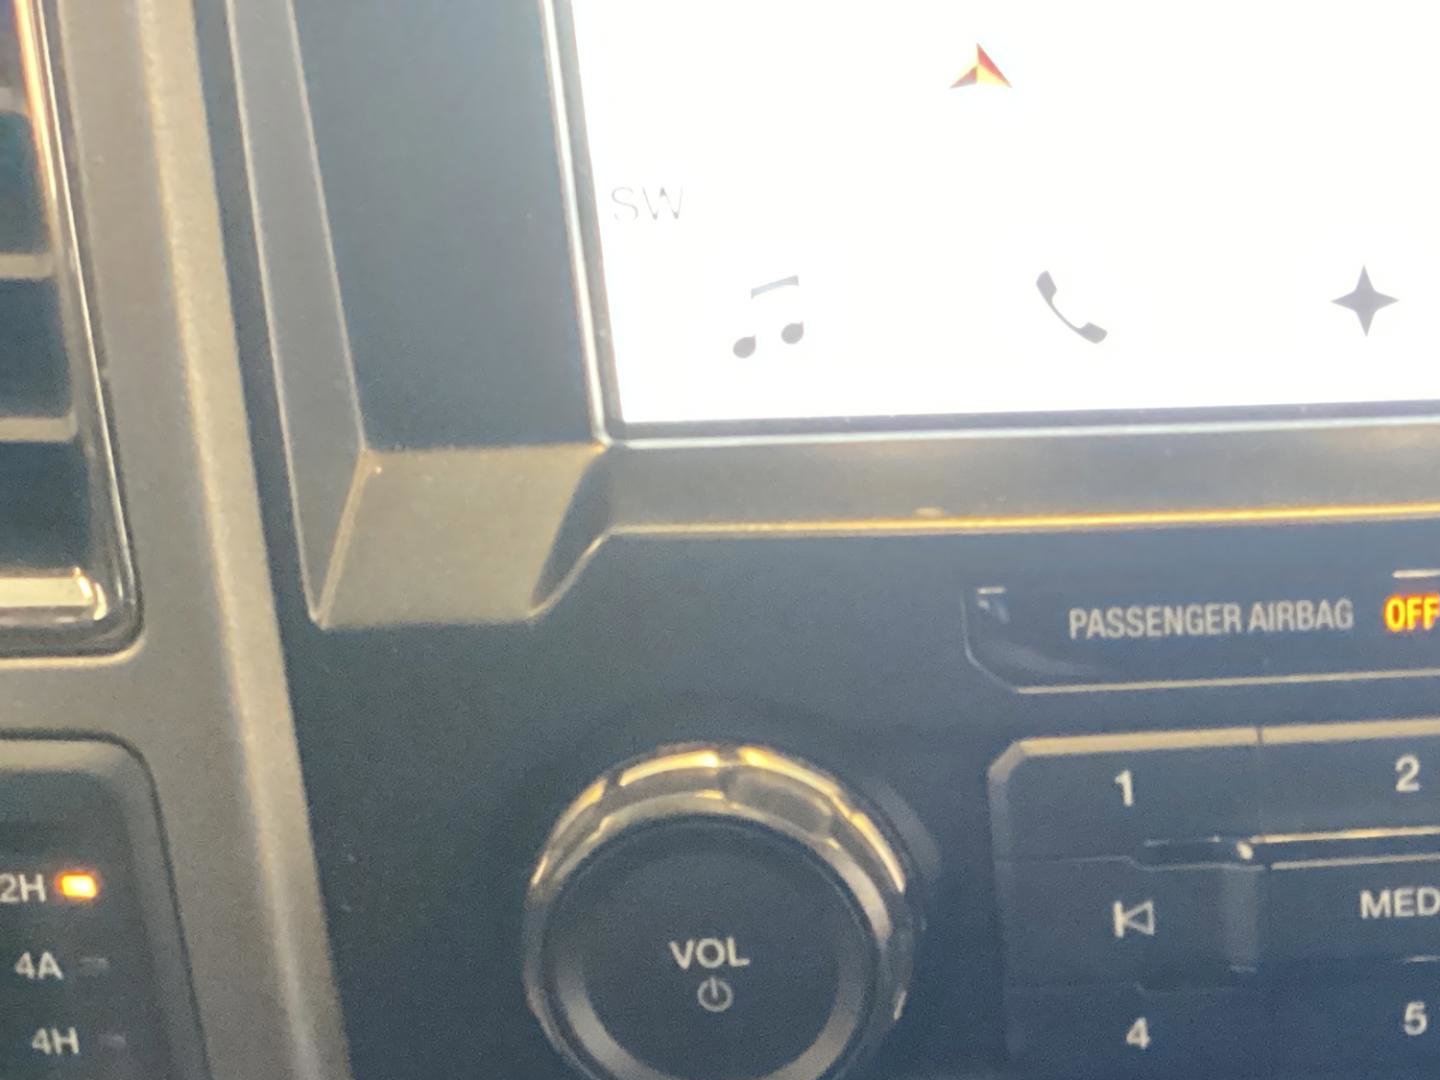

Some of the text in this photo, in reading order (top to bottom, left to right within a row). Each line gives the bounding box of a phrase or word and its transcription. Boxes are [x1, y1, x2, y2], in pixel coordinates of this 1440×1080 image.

[610, 185, 685, 221] SW
[1068, 605, 1242, 640] PASSENGER
[1247, 597, 1353, 634] AIRBAG
[1115, 770, 1135, 807] 1
[1394, 754, 1422, 793] 2
[0, 873, 47, 903] 2H
[14, 950, 64, 981] 4A
[668, 936, 751, 970] VOL
[1125, 1017, 1151, 1050] 4
[1402, 1000, 1429, 1037] 5
[31, 1026, 80, 1056] 4H
